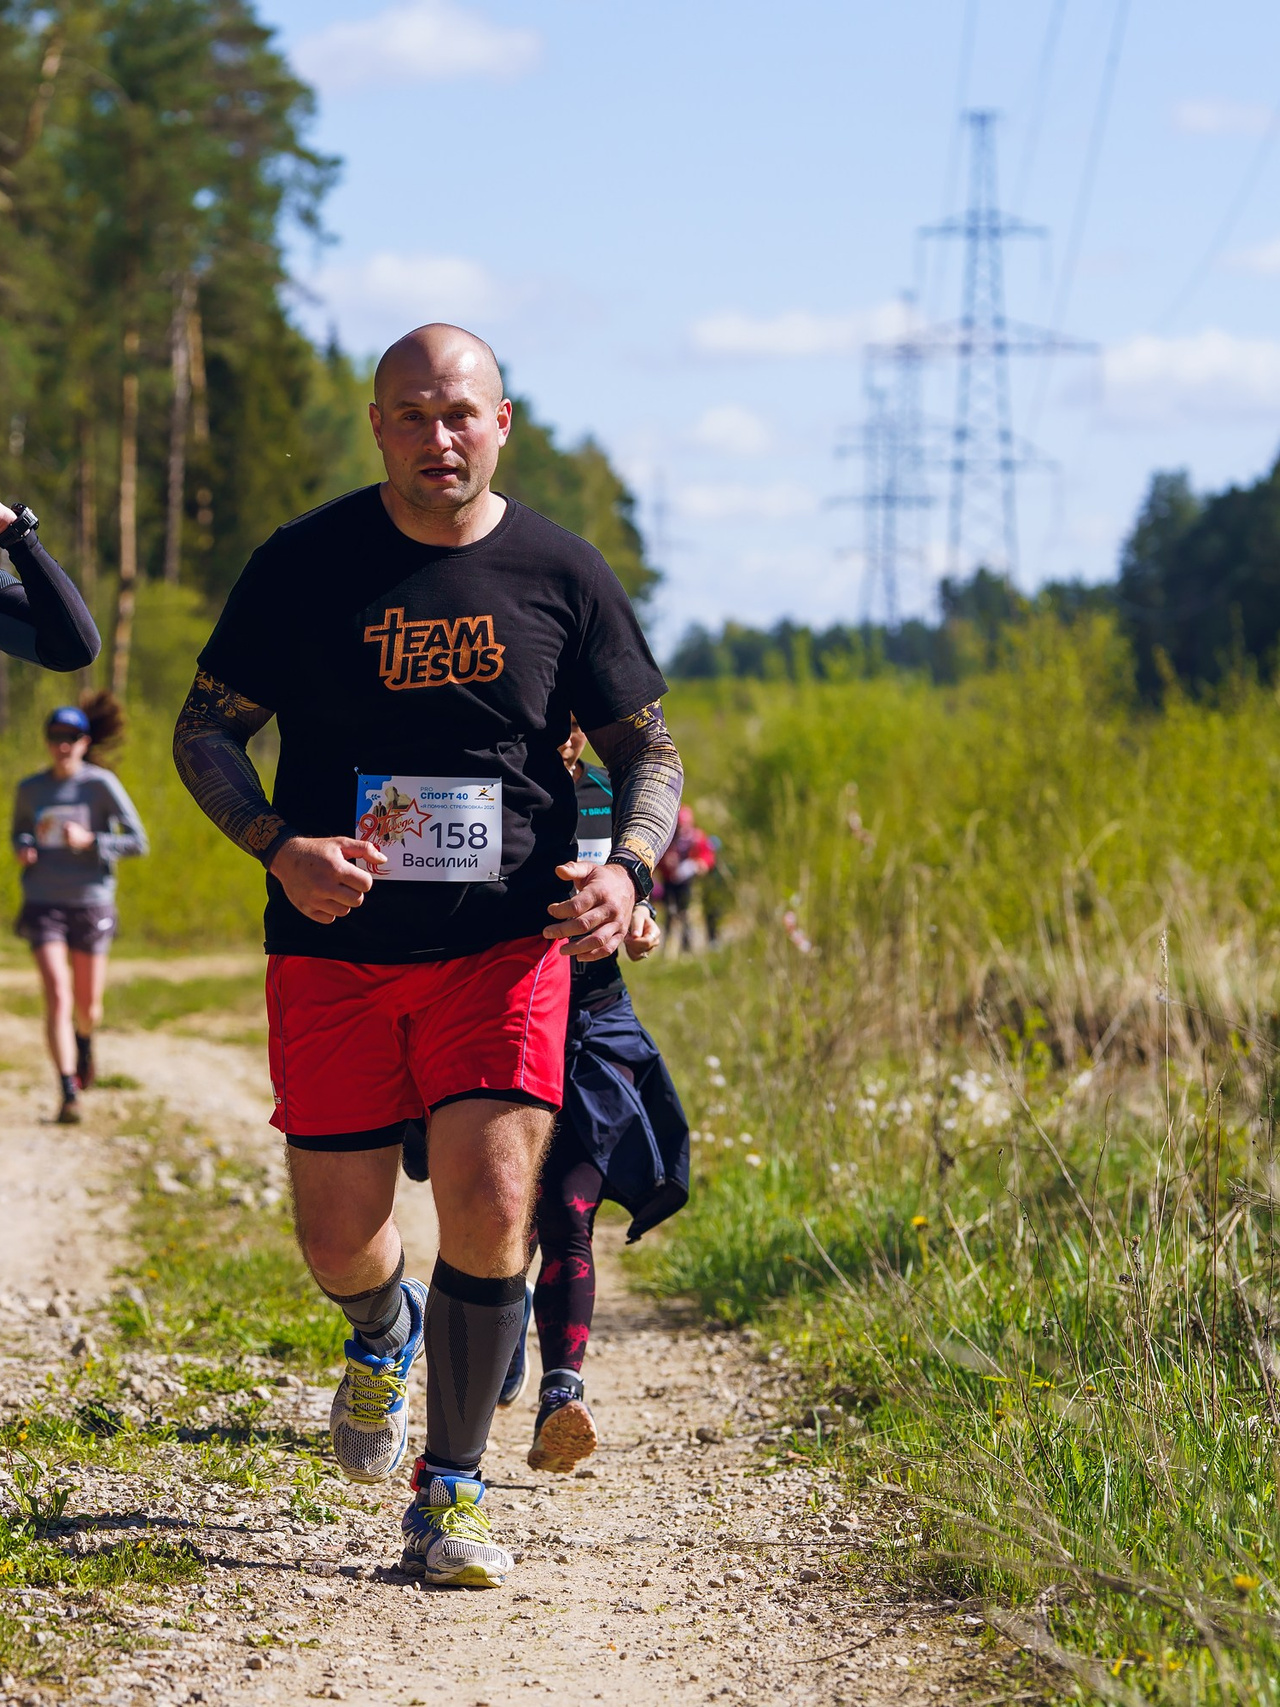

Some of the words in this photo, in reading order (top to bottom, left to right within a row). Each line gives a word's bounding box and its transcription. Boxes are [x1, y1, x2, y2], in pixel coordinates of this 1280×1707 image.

[365, 608, 493, 673] TEAM
[387, 646, 503, 689] JESUS
[420, 792, 454, 800] СПОРТ
[429, 822, 488, 849] 158
[402, 853, 478, 868] Василий
